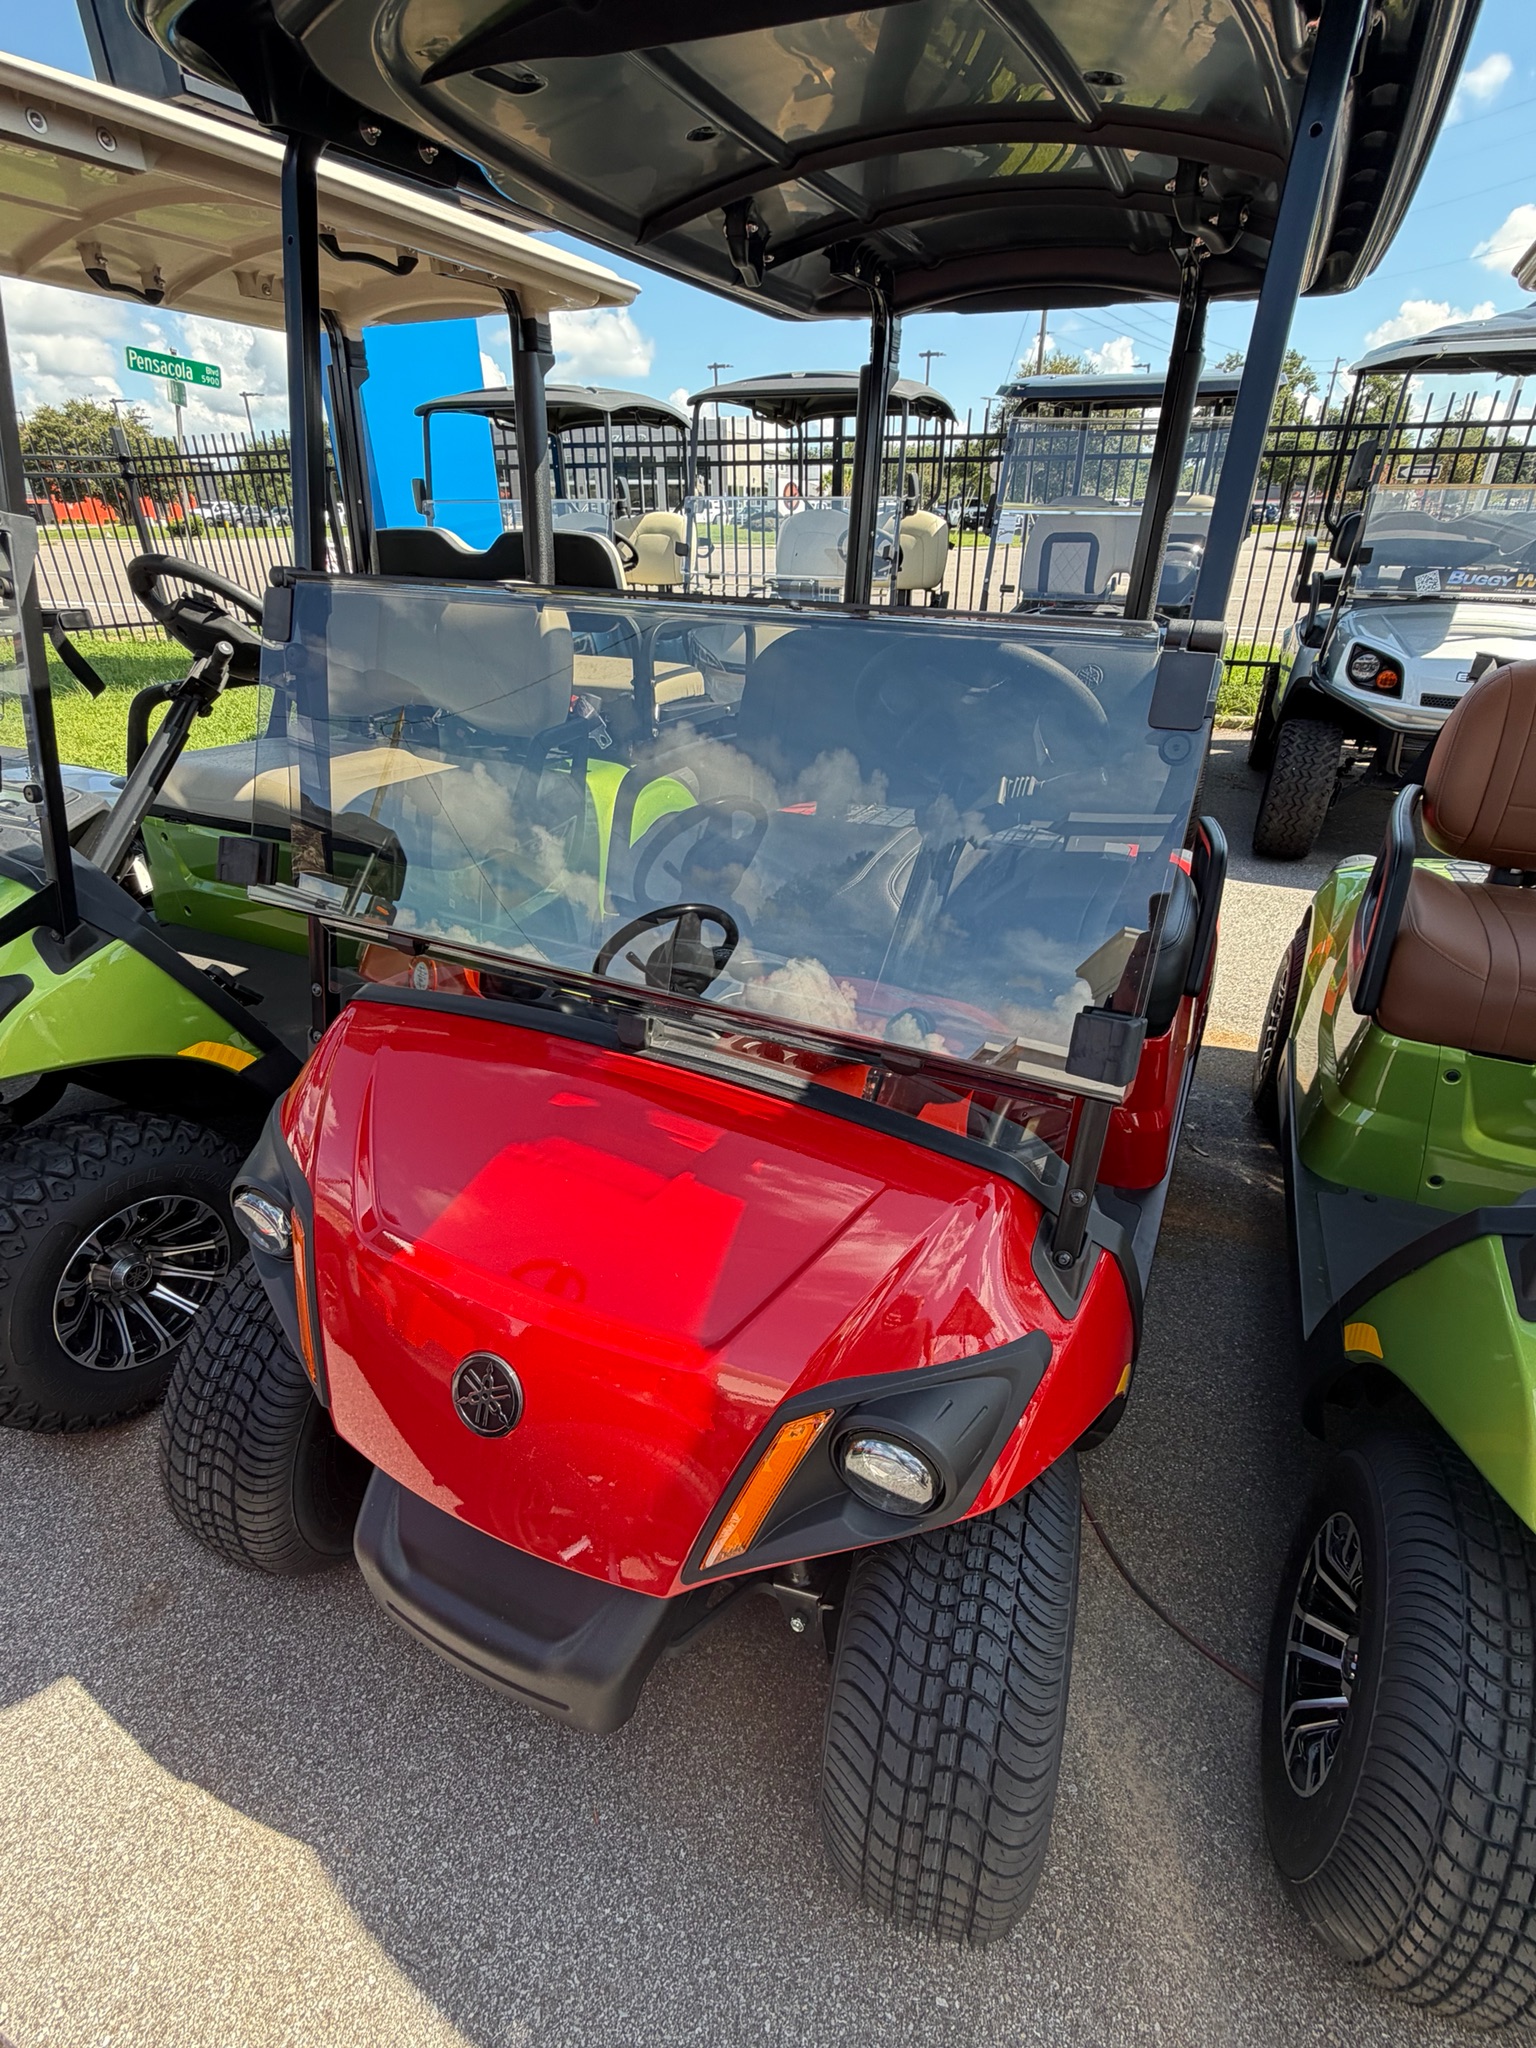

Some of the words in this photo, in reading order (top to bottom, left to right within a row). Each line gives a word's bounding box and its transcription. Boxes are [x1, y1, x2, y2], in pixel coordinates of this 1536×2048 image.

[128, 349, 194, 381] Pensacola
[205, 366, 219, 377] Blvd
[201, 374, 220, 387] 5900
[1447, 570, 1515, 586] BUGGY
